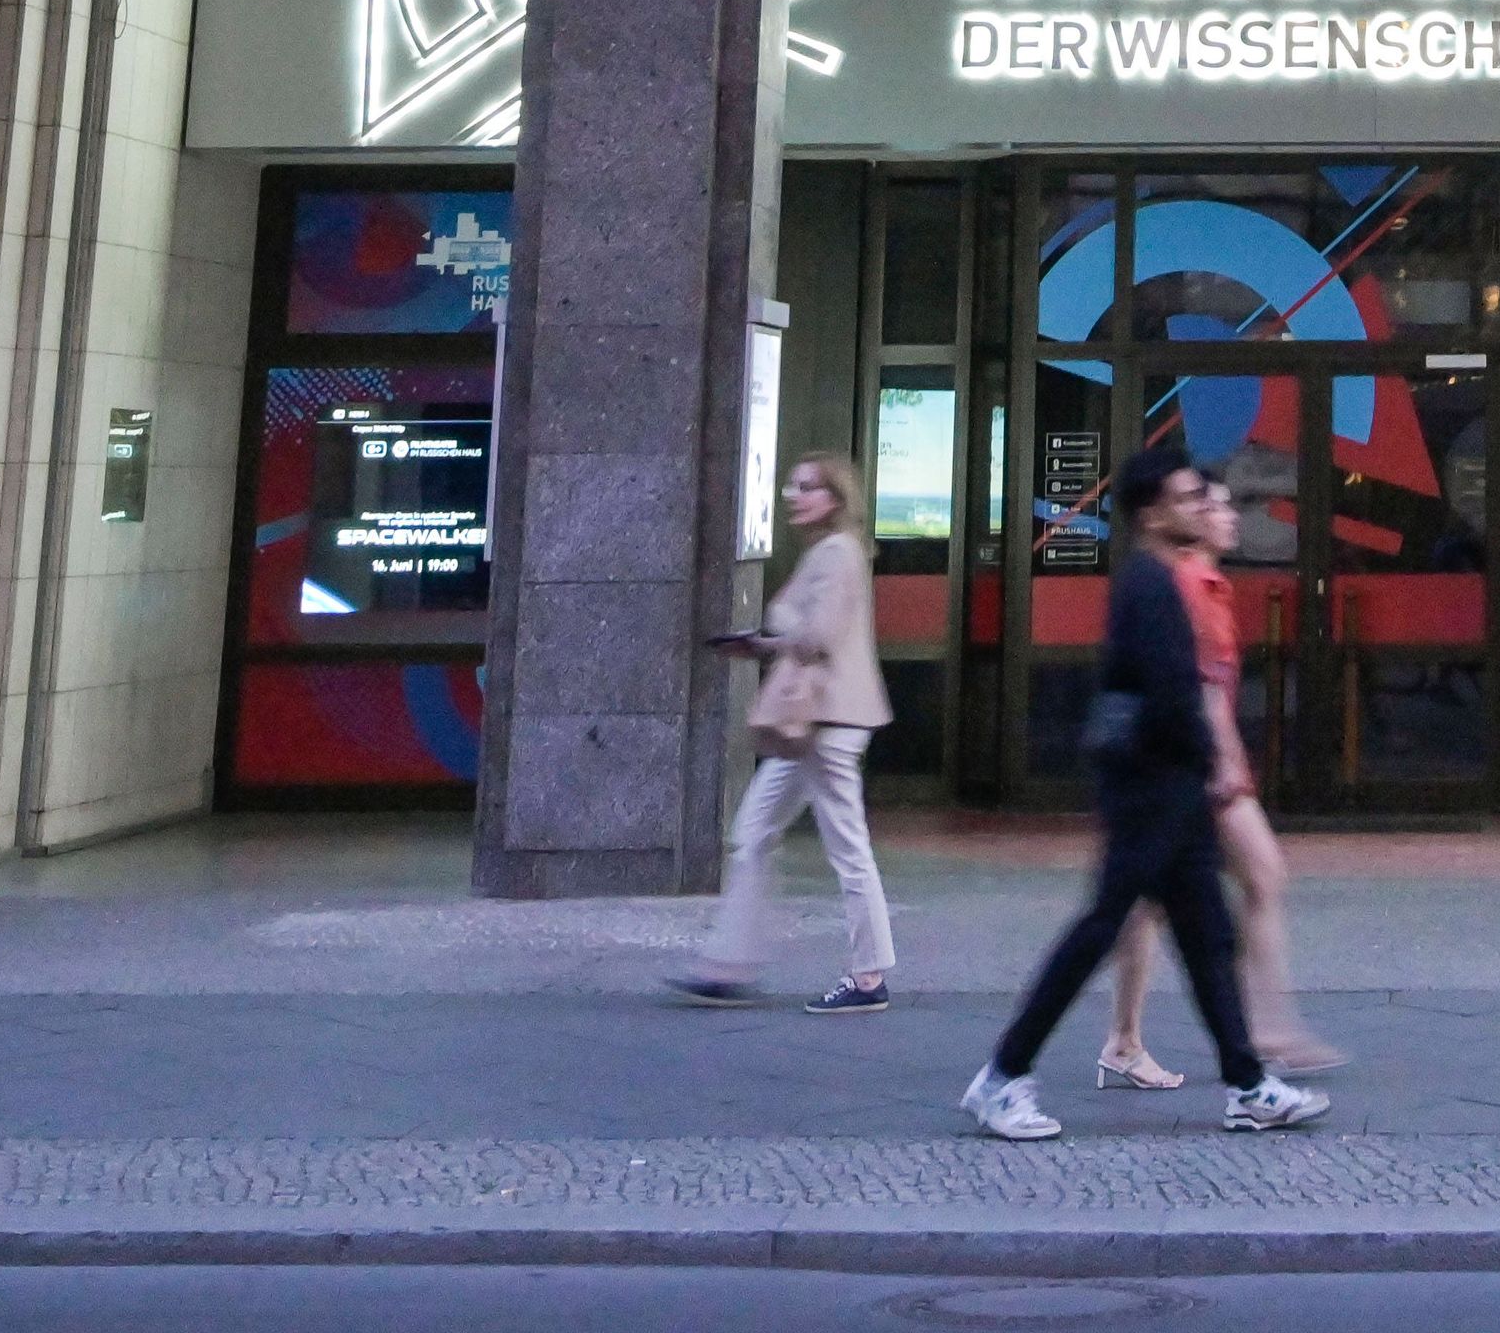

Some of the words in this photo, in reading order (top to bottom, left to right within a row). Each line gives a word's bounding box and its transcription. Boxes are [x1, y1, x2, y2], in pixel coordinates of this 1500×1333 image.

[961, 20, 1090, 70] DER
[389, 558, 413, 572] Juni
[427, 558, 459, 572] 19:00
